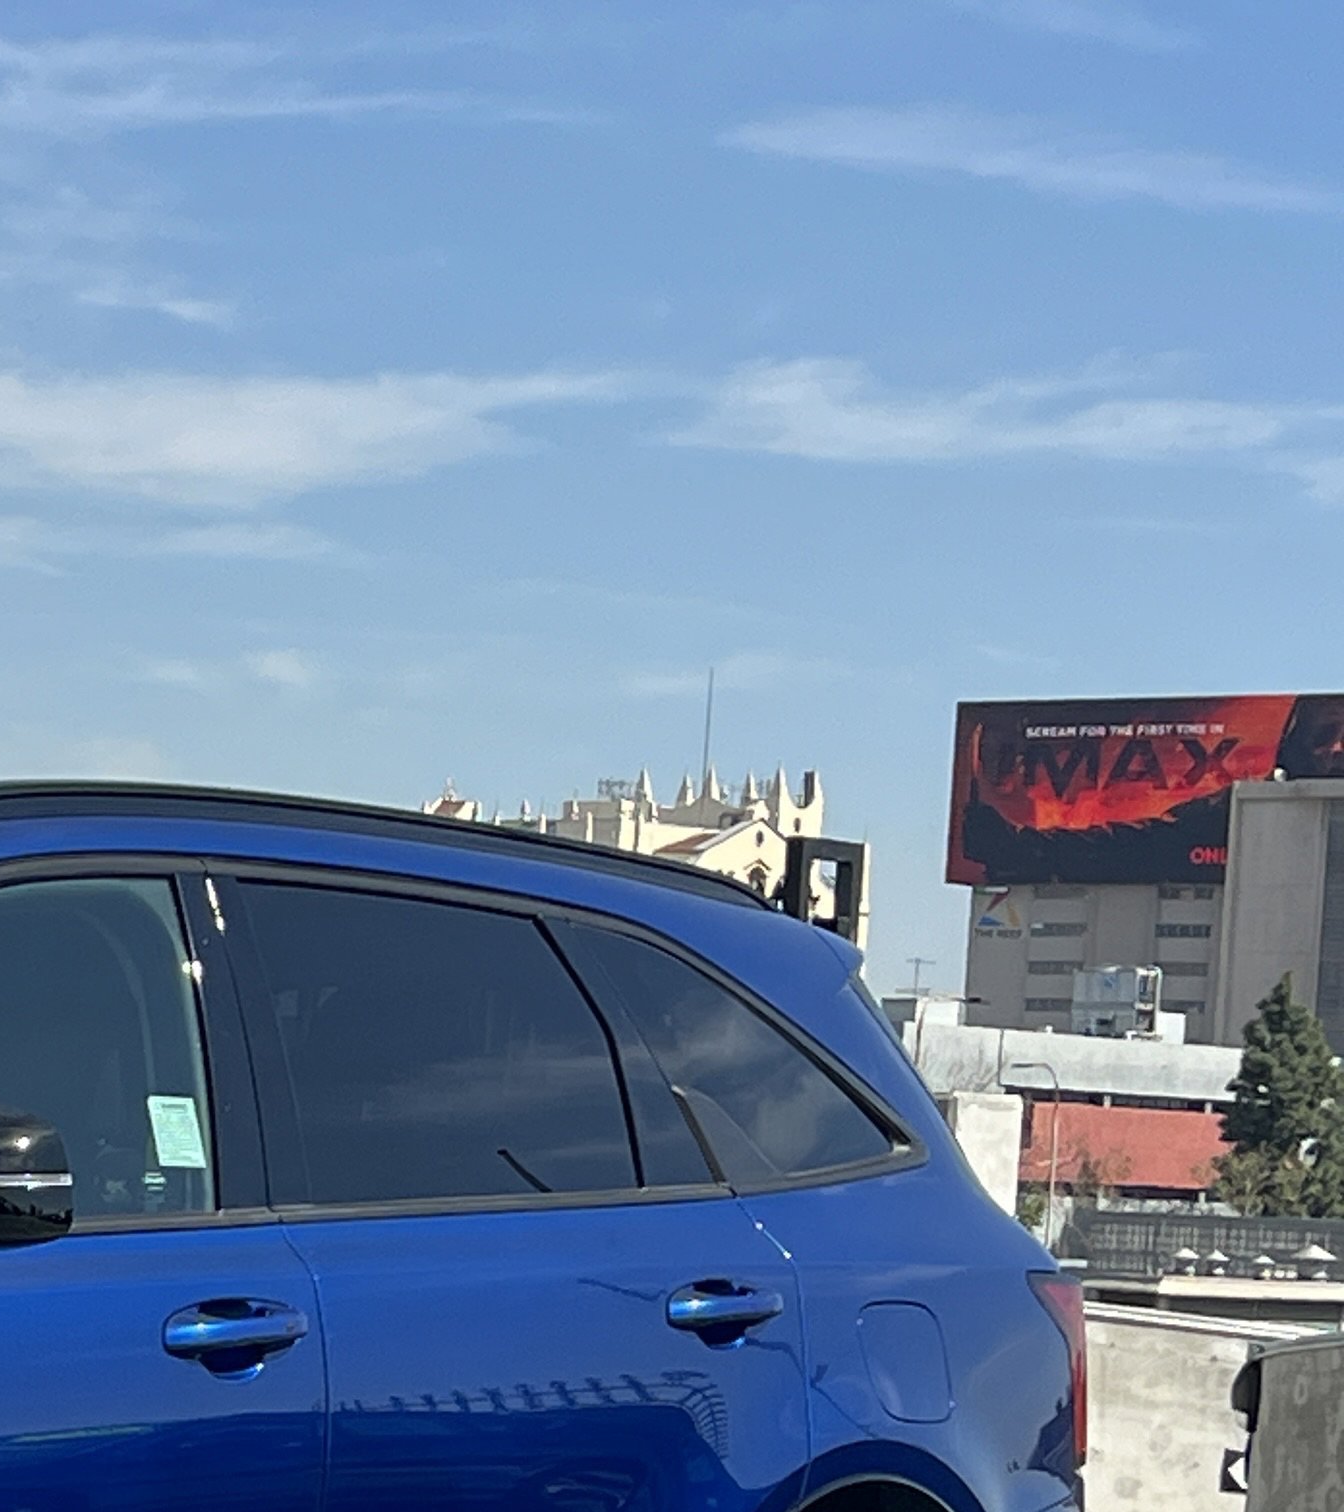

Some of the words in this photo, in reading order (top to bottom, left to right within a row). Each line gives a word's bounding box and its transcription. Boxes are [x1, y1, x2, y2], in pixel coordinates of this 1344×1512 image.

[1026, 725, 1076, 739] SCREAM
[1079, 725, 1106, 737] FOR
[1109, 724, 1134, 737] THE
[1137, 724, 1173, 736] FIRST
[1176, 723, 1207, 735] TIME
[1209, 723, 1225, 735] IN
[975, 928, 993, 938] THE
